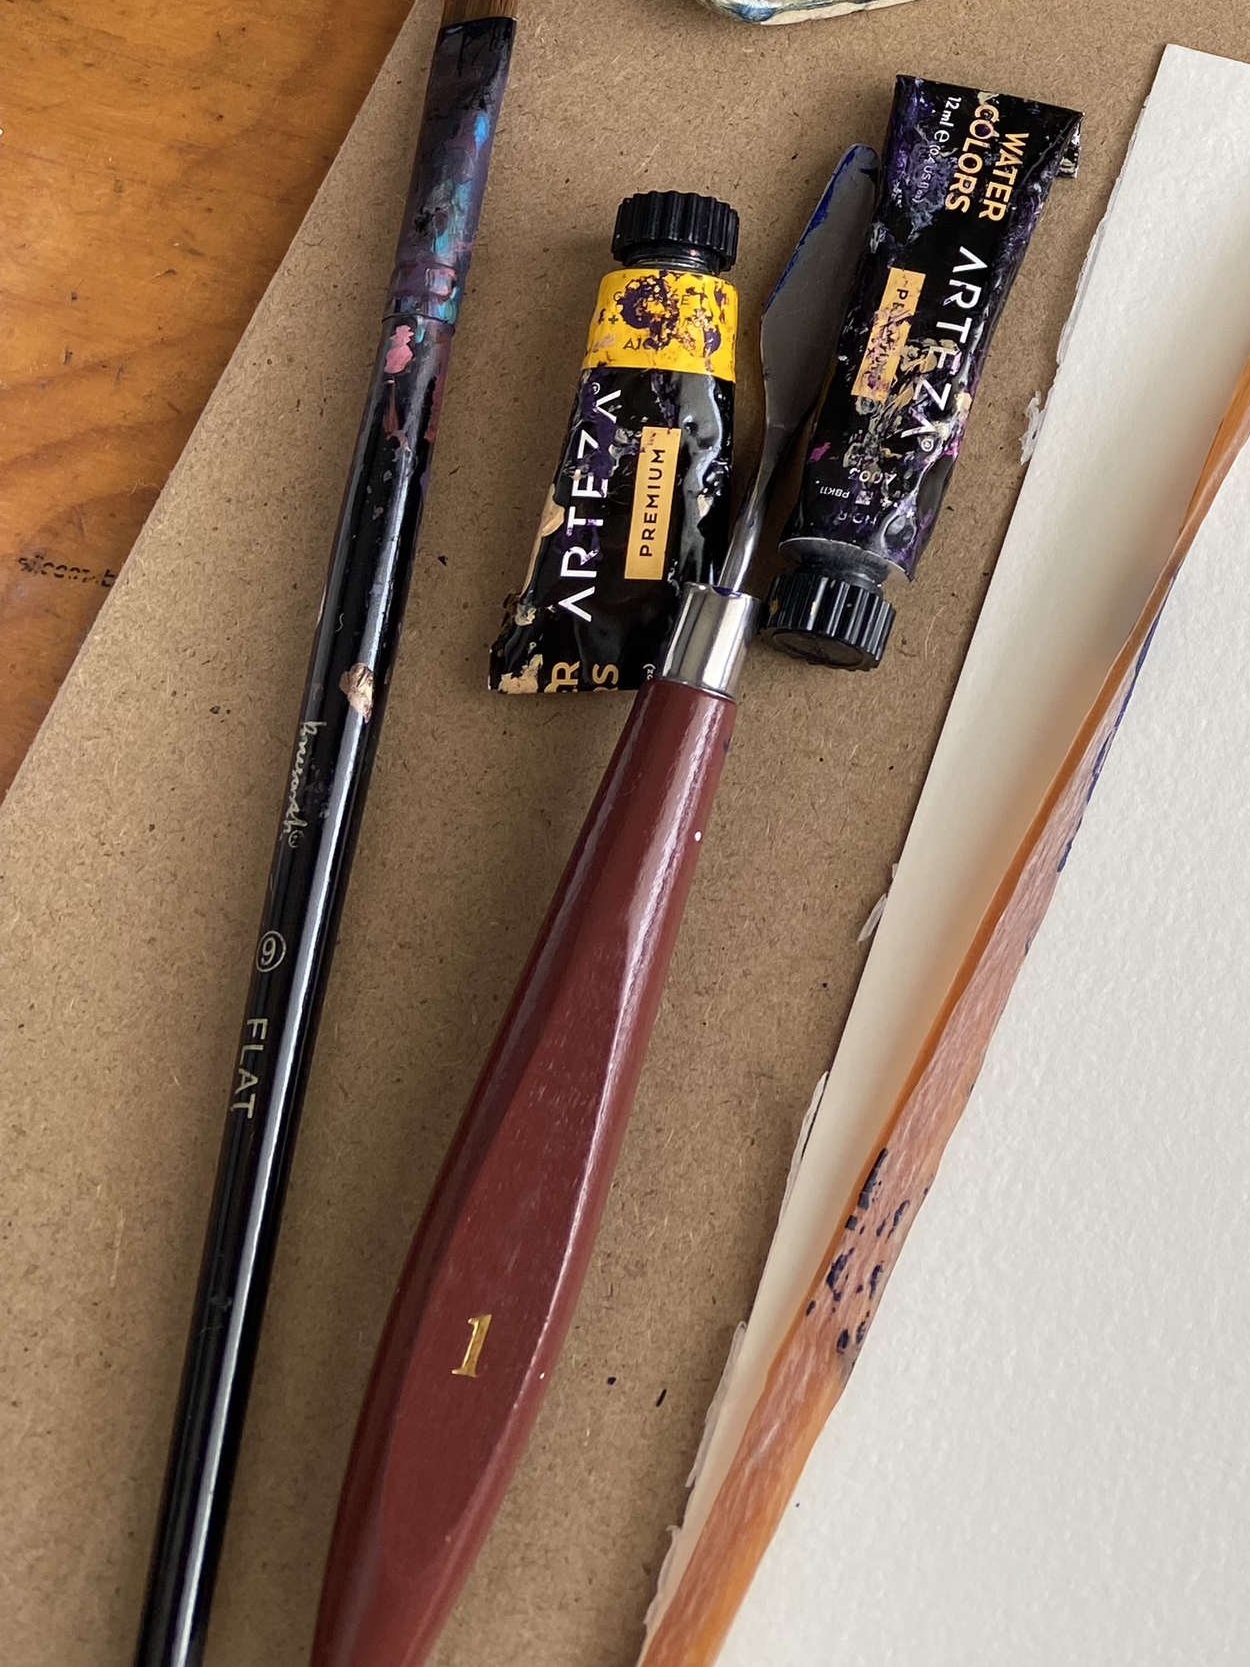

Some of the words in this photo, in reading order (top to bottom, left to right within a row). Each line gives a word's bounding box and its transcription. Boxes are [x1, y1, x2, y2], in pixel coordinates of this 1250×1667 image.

[944, 103, 1000, 214] COLORS
[978, 132, 1030, 222] WATER
[639, 447, 666, 557] PREMIUM
[819, 485, 850, 500] PBK11
[230, 1017, 269, 1120] FLAT
[450, 1313, 493, 1379] 1
